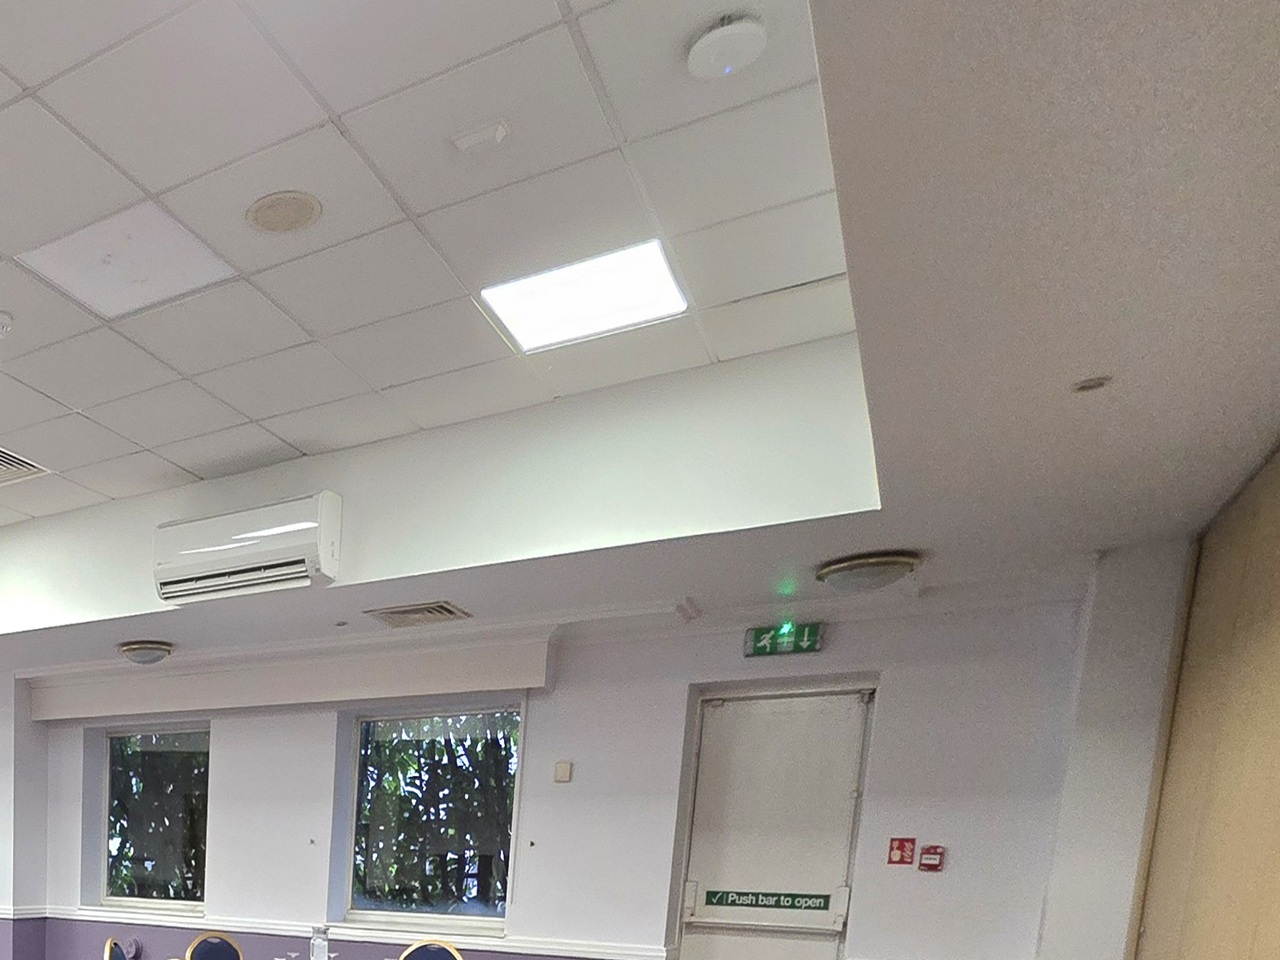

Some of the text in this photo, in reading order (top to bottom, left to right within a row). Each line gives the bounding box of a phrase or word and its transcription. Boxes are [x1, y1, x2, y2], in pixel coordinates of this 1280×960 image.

[728, 893, 824, 909] Push bar to open
